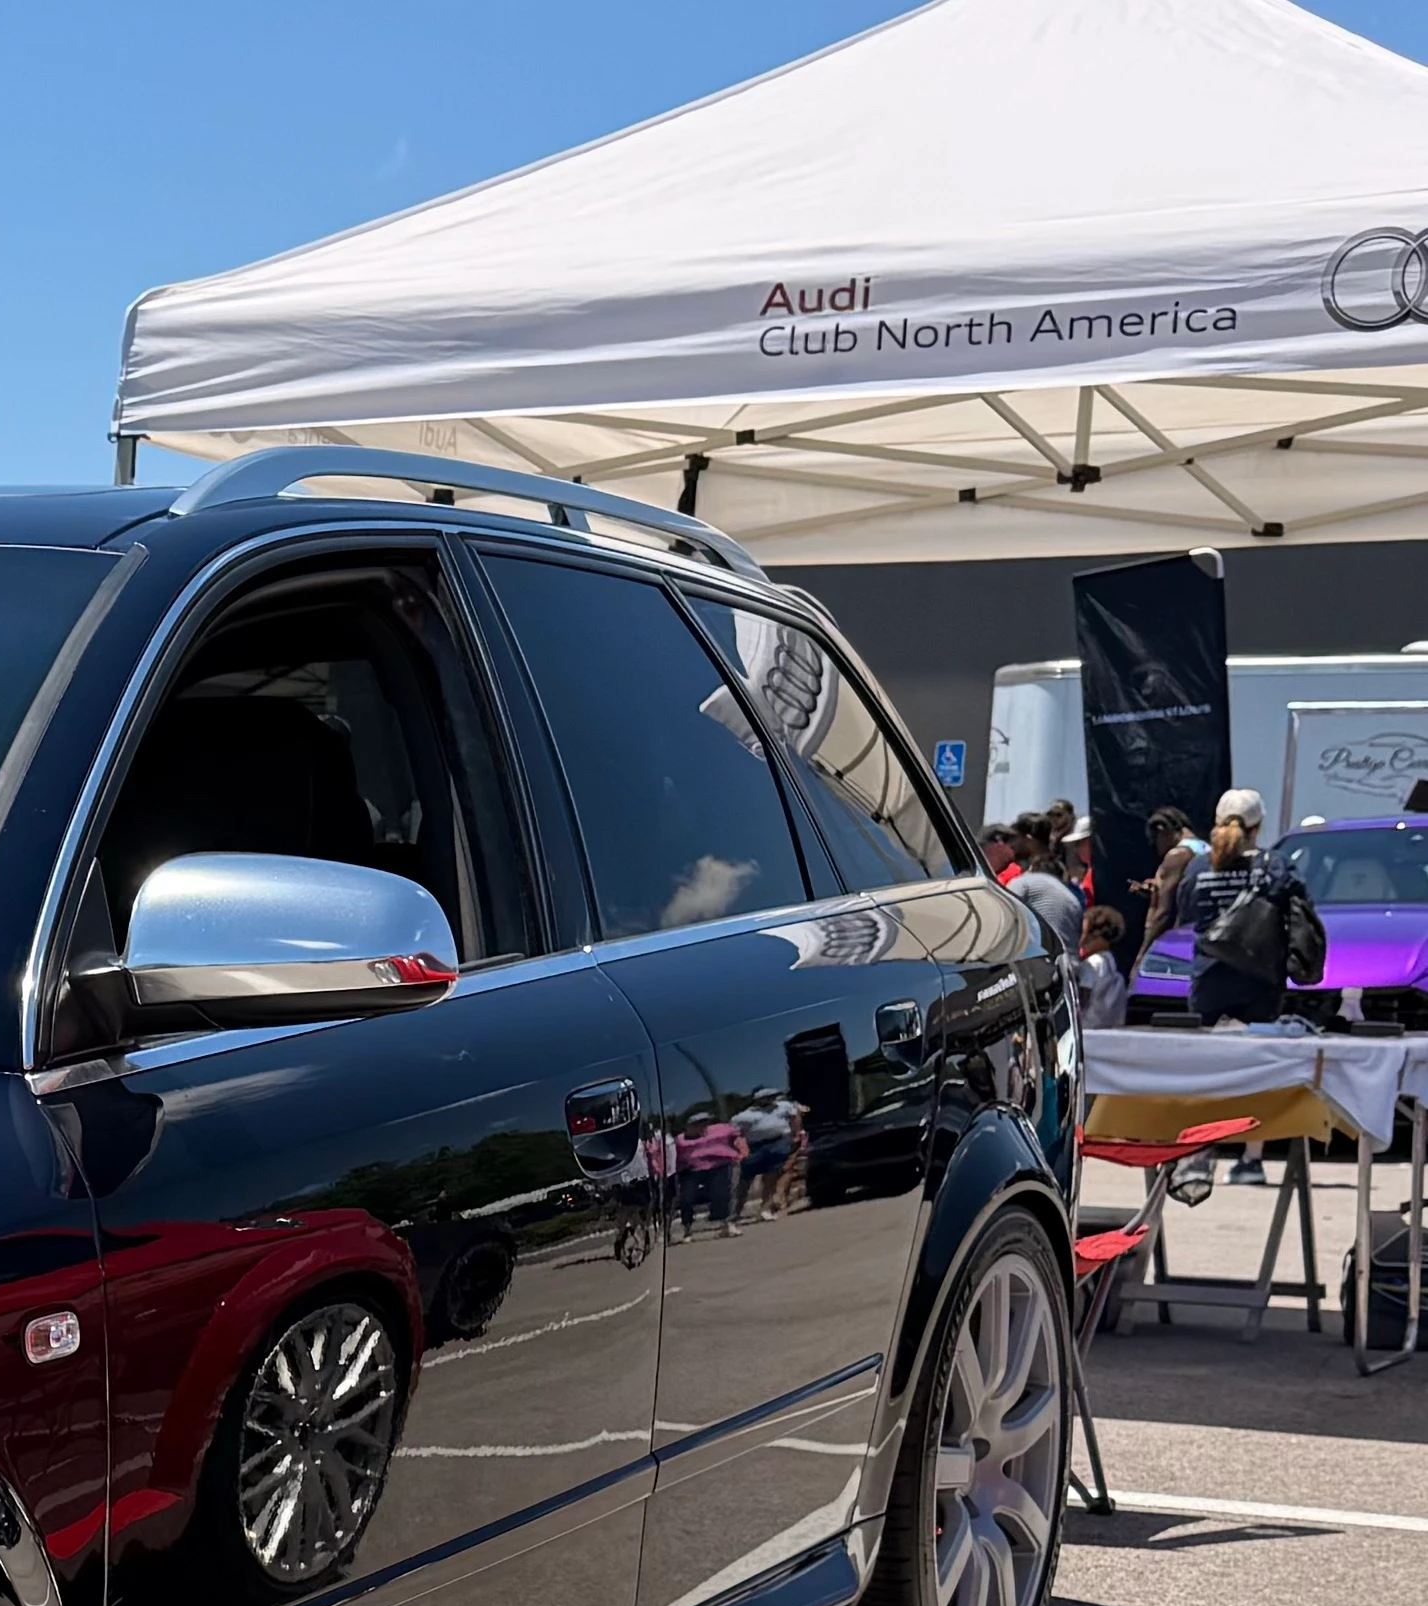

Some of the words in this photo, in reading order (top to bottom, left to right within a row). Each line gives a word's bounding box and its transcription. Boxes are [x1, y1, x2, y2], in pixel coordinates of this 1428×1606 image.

[759, 276, 872, 317] Audi
[759, 320, 858, 357] Club
[876, 311, 1014, 351] North
[1029, 300, 1239, 342] America
